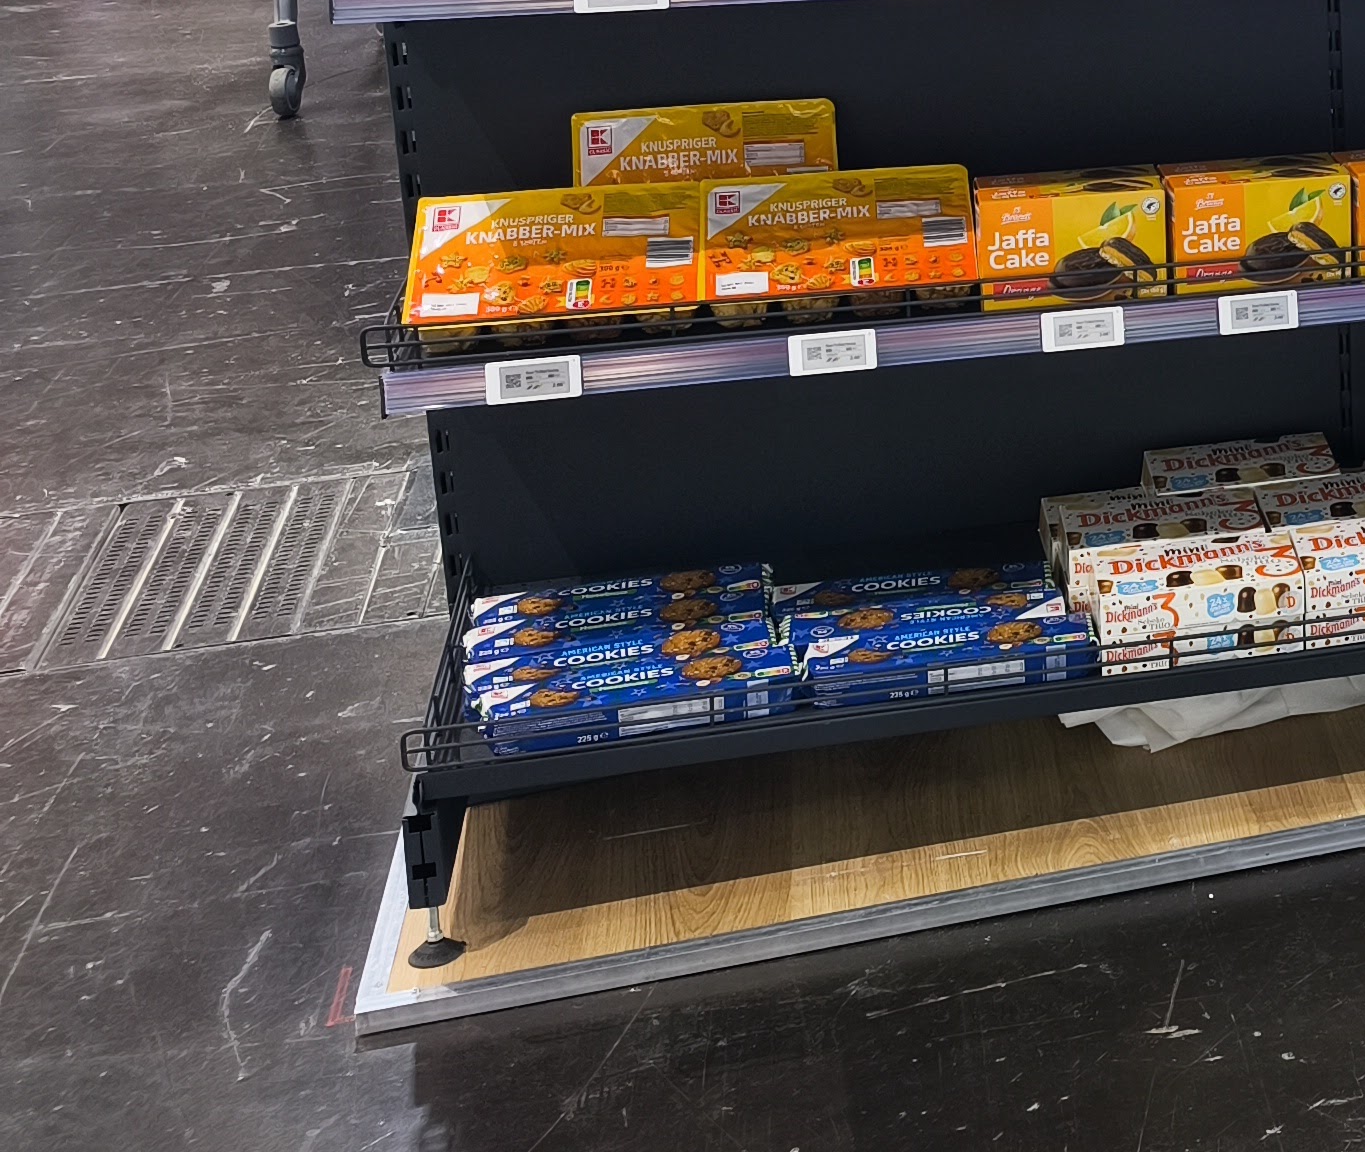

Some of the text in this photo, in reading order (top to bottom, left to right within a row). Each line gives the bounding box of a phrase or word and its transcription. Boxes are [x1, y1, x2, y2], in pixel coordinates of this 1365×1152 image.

[640, 136, 717, 154] KNUSPRIGER
[619, 148, 738, 172] KNABBER-MIX
[769, 197, 847, 212] KNUSPRIGER
[490, 213, 574, 229] KNUSPRIGER
[748, 204, 871, 227] KNABBER-MIX
[1181, 213, 1242, 236] Jaffa
[465, 222, 597, 246] KNABBER-MIX
[987, 228, 1050, 251] Jaffa
[1183, 234, 1242, 255] Cake
[988, 250, 1050, 270] Cake
[1161, 437, 1302, 473] Dickmann's
[1075, 492, 1228, 529] Dickmann's
[1108, 539, 1265, 576] Dickmann's
[1163, 544, 1208, 557] mini
[557, 578, 654, 596] COOKIES
[851, 575, 941, 592] COOKIES
[1309, 576, 1361, 599] Dickmann's
[1105, 601, 1159, 624] Dickmann's
[1285, 595, 1296, 609] D
[554, 608, 653, 629] COOKIES
[900, 605, 992, 622] COOKIES
[886, 630, 981, 651] COOKIES
[894, 629, 941, 642] AMERICAN
[553, 644, 655, 668] COOKIES
[560, 644, 611, 658] AMERICAN
[571, 667, 674, 690] COOKIES
